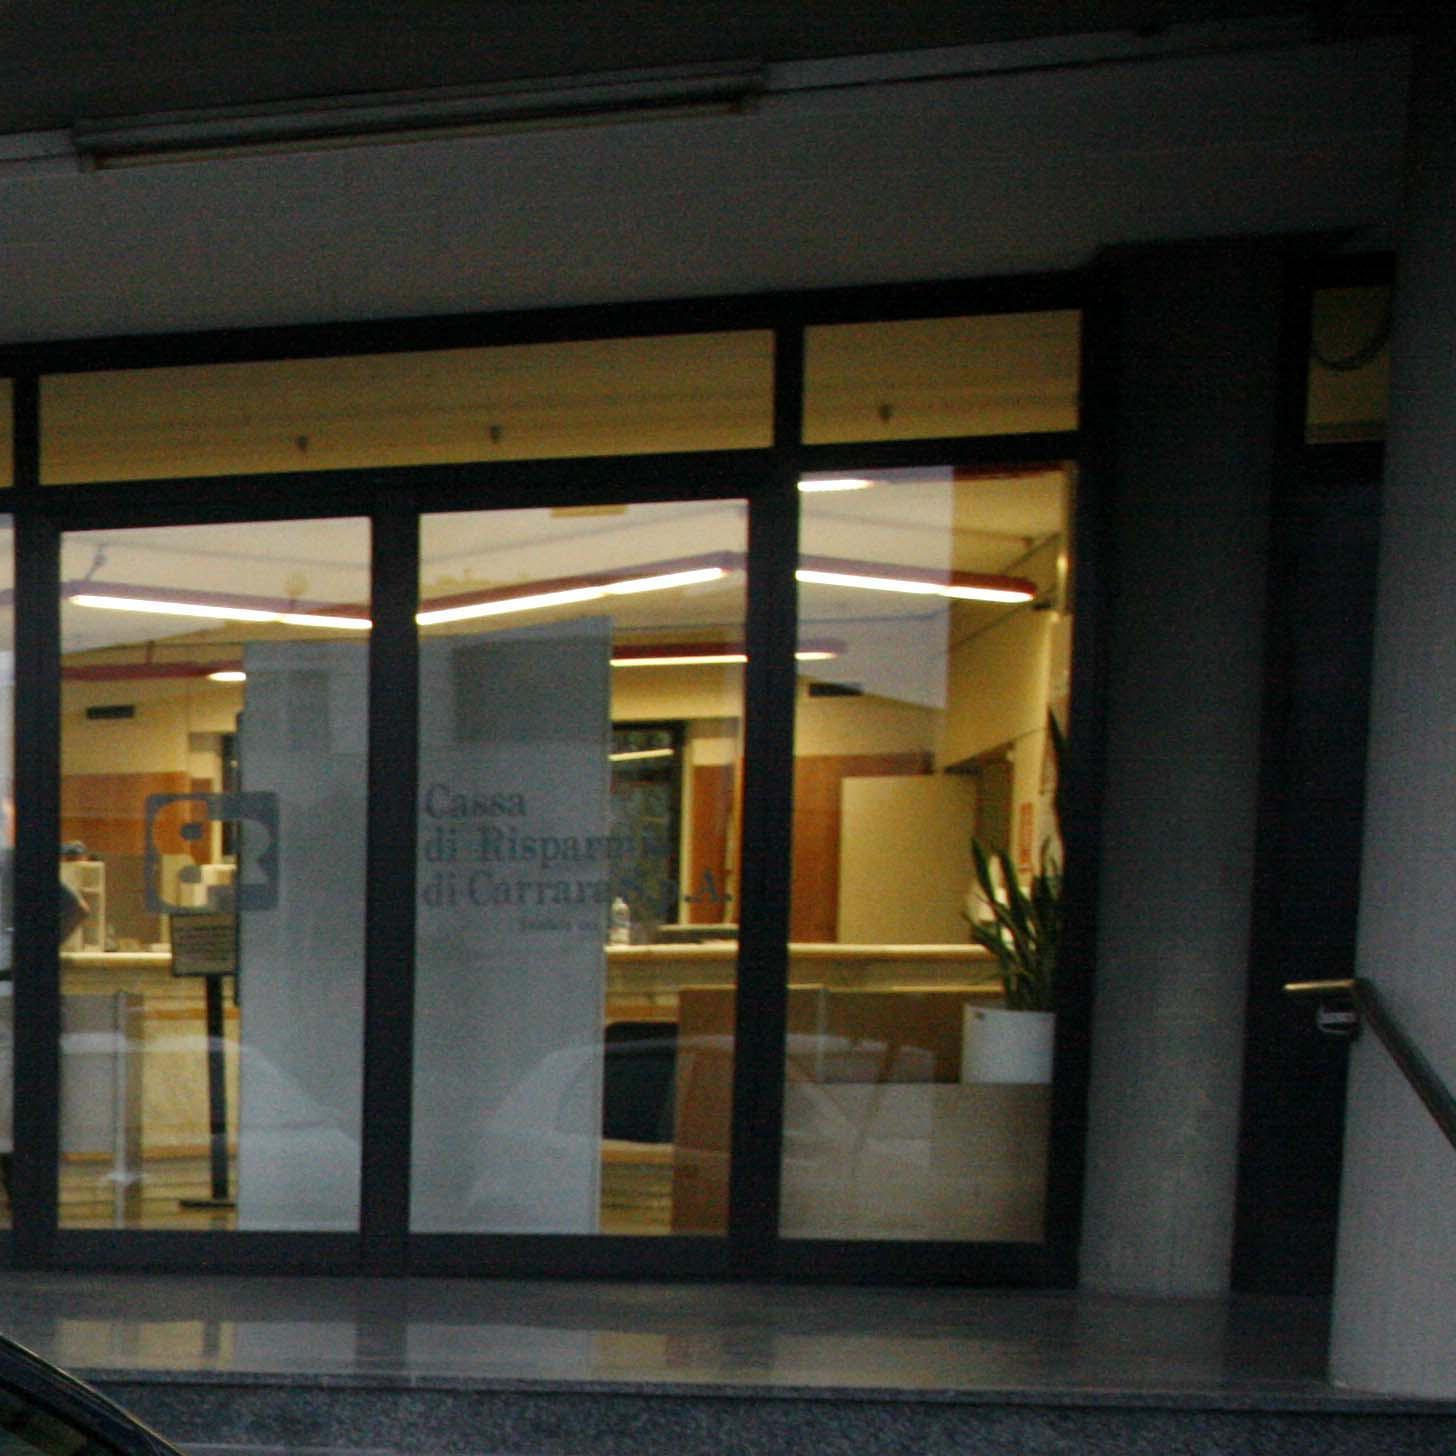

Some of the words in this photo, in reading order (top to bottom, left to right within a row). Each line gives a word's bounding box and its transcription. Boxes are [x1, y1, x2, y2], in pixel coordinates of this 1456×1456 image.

[424, 782, 528, 820] Cassa
[423, 825, 458, 863] di
[422, 872, 456, 907] di
[467, 870, 614, 907] Carrara
